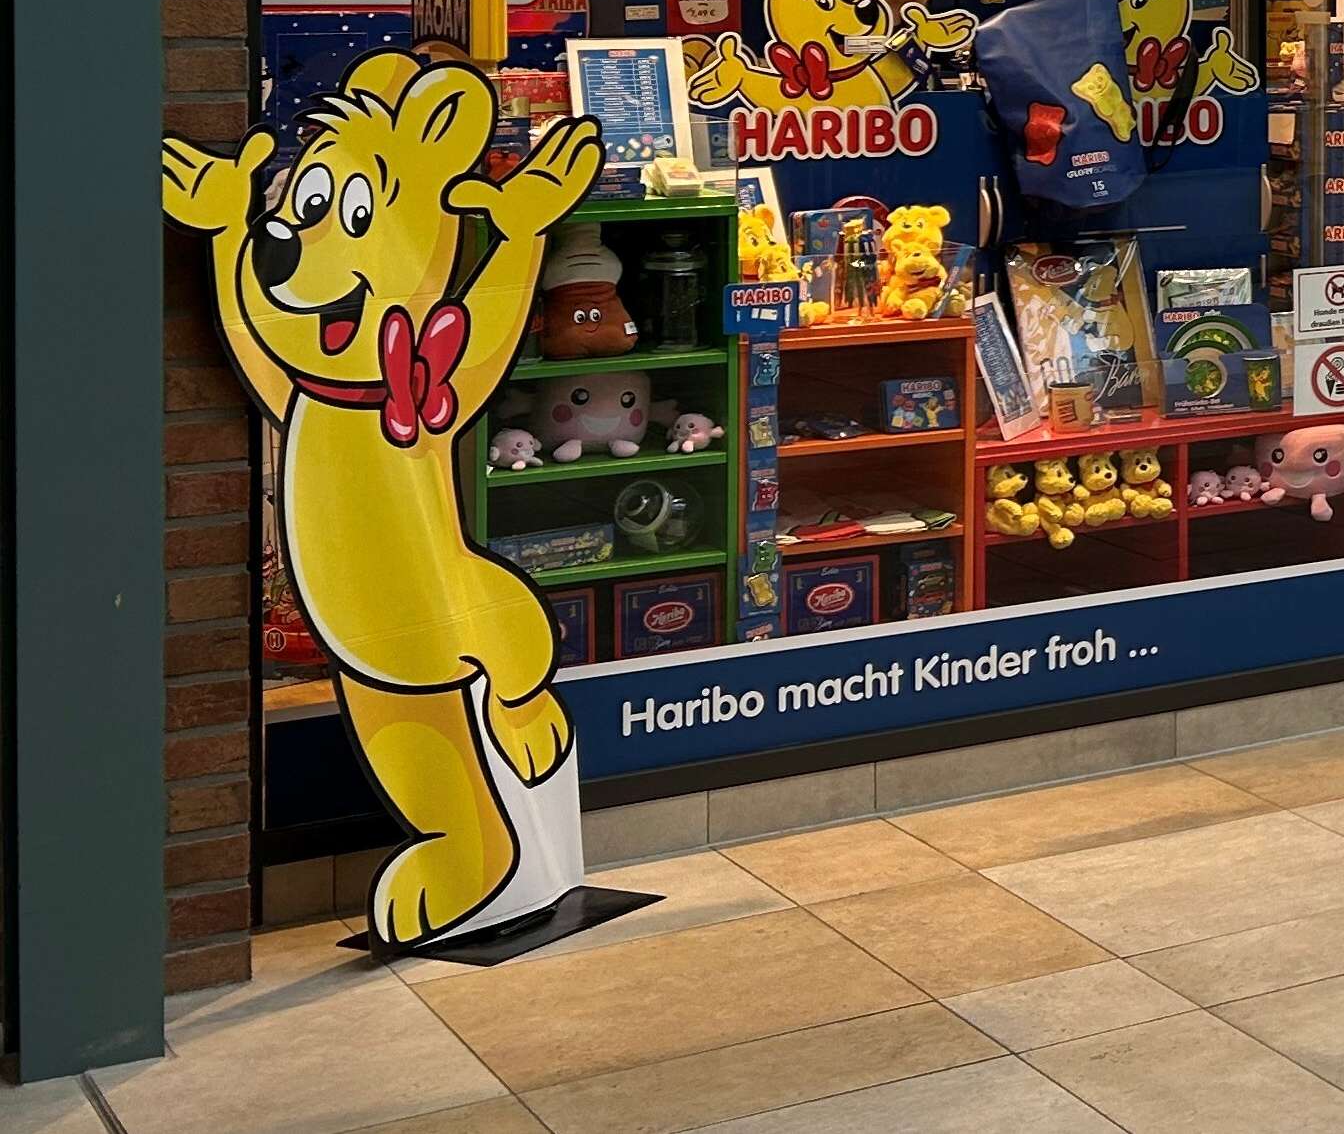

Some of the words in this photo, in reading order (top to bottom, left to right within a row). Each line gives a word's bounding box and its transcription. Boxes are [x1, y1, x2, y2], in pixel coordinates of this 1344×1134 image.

[734, 107, 934, 158] HARIBO
[1073, 151, 1109, 166] HARIBO
[732, 286, 793, 307] HARIBO
[900, 380, 941, 393] HARIBO
[622, 686, 765, 737] Haribo
[777, 663, 904, 714] macht
[914, 645, 1037, 691] Kinder
[1043, 629, 1117, 670] froh
